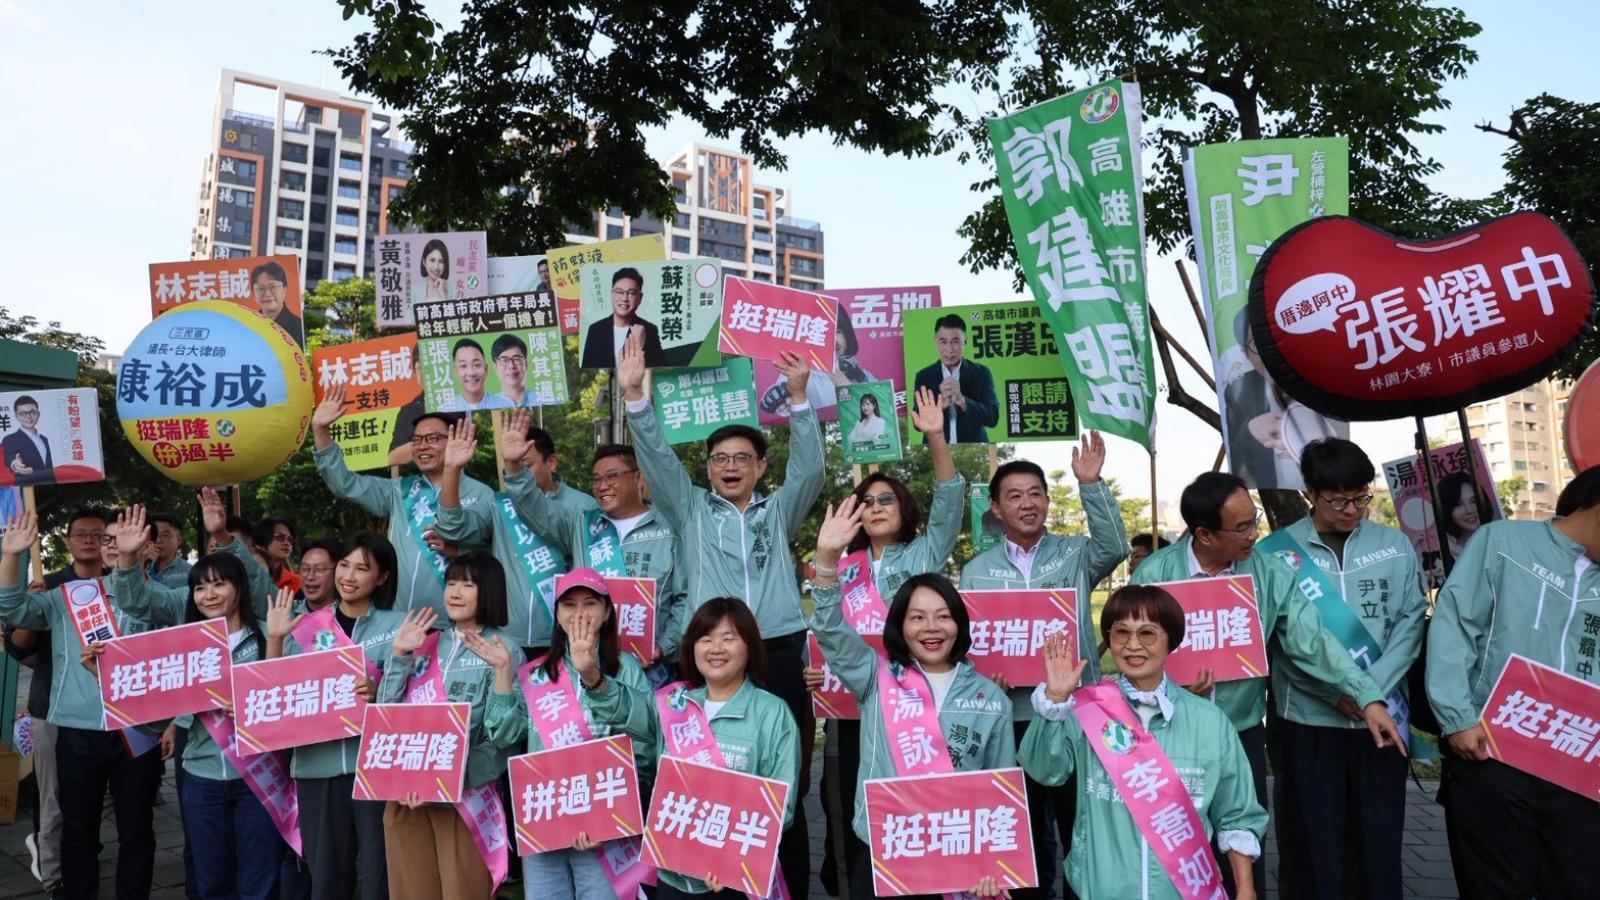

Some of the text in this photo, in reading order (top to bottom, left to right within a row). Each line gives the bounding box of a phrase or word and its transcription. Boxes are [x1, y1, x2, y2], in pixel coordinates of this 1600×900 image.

[379, 239, 403, 321] 黃敬雅
[552, 248, 605, 274] 防蚊液
[1002, 115, 1147, 426] 郭建盟
[155, 268, 252, 304] 林志誠
[416, 292, 552, 321] 前高雄市政府青年局長
[661, 265, 684, 341] 蘇致榮
[1279, 284, 1349, 328] 厝邊阿中
[418, 310, 555, 338] 給年輕新人一個機會!
[728, 299, 829, 347] 挺瑞隆
[983, 306, 1041, 321] 高雄市議員
[1339, 246, 1572, 371] 張耀中
[174, 329, 204, 338] 三民區
[318, 346, 413, 391] 林志誠
[428, 340, 457, 411] 張以理
[678, 367, 730, 390] 第4選區
[1368, 329, 1545, 392] 林園大寮 市議員參選人
[117, 358, 267, 408] 康裕成
[1021, 380, 1067, 406] 懇請
[136, 417, 211, 442] 挺瑞隆
[662, 390, 752, 430] 李雅慧
[1022, 408, 1069, 434] 支持
[631, 528, 671, 541] TAIWAN
[1353, 546, 1398, 567] TAIWAN
[1531, 562, 1566, 590] TEAM
[613, 603, 648, 637] 隆
[1357, 579, 1380, 619] 尹立
[1170, 605, 1253, 654] 瑞隆
[1576, 612, 1600, 680] 張耀中
[110, 647, 223, 703] 挺瑞隆
[244, 673, 357, 728] 挺瑞隆
[953, 697, 1003, 712] TAIWAN
[887, 687, 939, 770] 湯詠
[363, 731, 458, 772] 挺瑞隆
[522, 765, 629, 826] 拼過半
[654, 790, 772, 856] 拼過半
[881, 804, 1019, 861] 挺瑞隆
[1121, 757, 1214, 898] 李喬如
